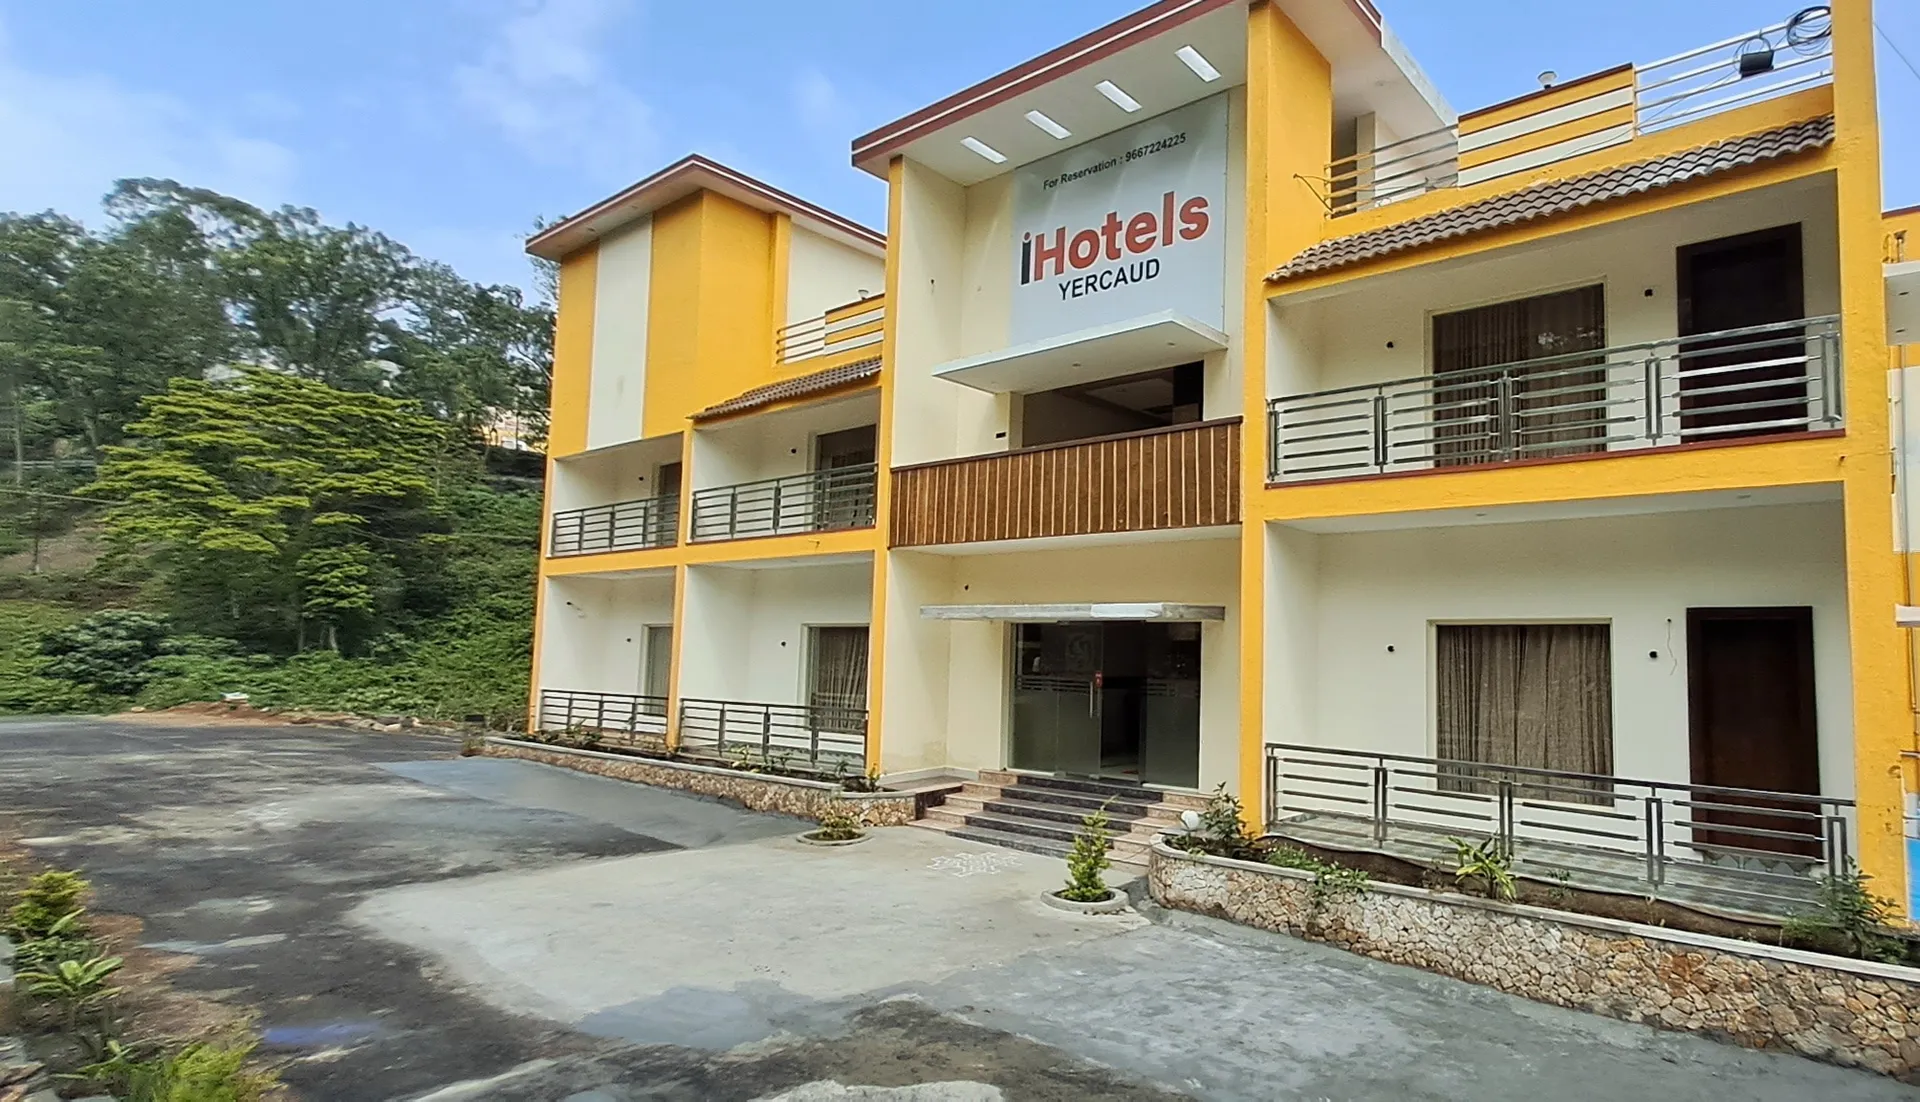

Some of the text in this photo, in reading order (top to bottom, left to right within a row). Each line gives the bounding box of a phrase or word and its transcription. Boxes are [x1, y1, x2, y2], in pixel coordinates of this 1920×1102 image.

[1043, 178, 1058, 190] For
[1060, 157, 1117, 184] Reservation
[1125, 133, 1186, 163] 9667224225
[1021, 191, 1209, 285] iHotels
[1058, 258, 1160, 301] YERCAUD
